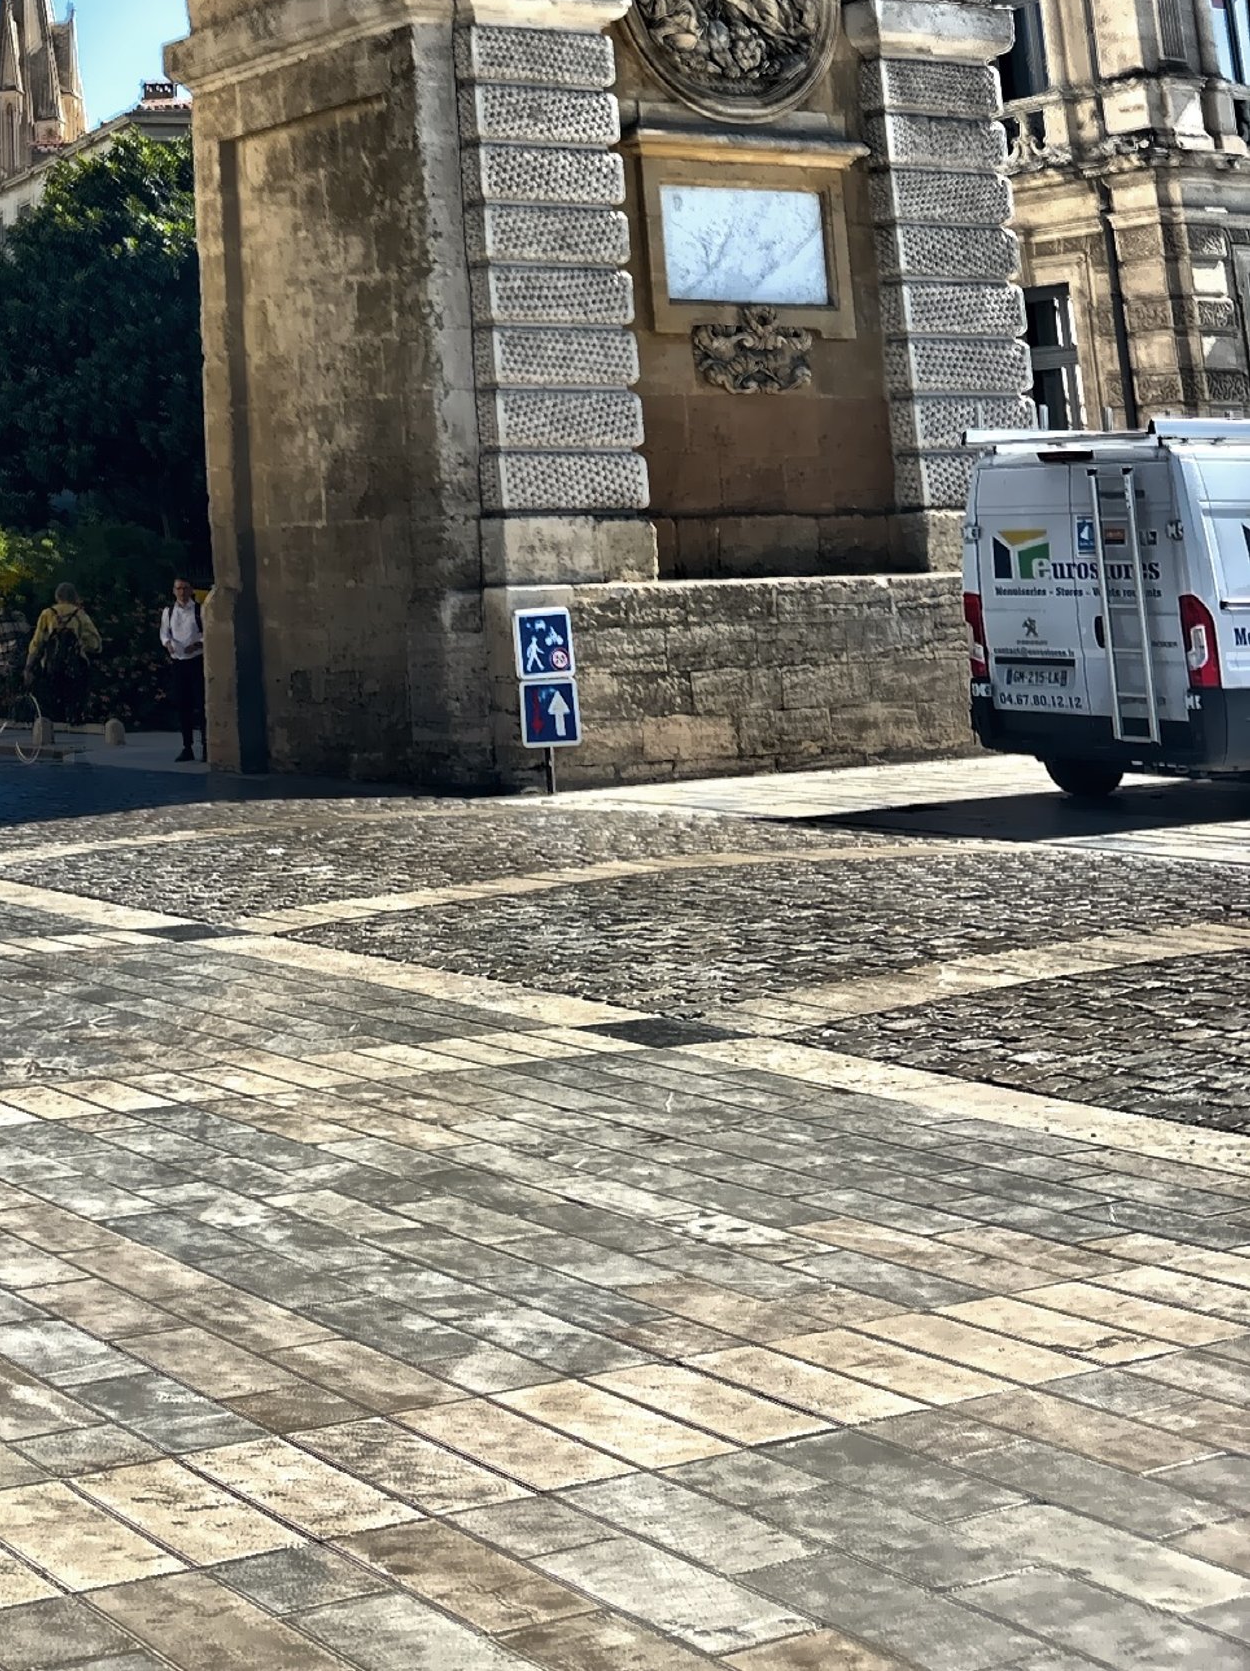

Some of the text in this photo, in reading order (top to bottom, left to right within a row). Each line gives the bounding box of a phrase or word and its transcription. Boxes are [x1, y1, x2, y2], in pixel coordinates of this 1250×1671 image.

[1031, 558, 1161, 580] eurosors
[1055, 587, 1084, 597] Stores
[1000, 692, 1083, 709] 04.67.80.12.12
